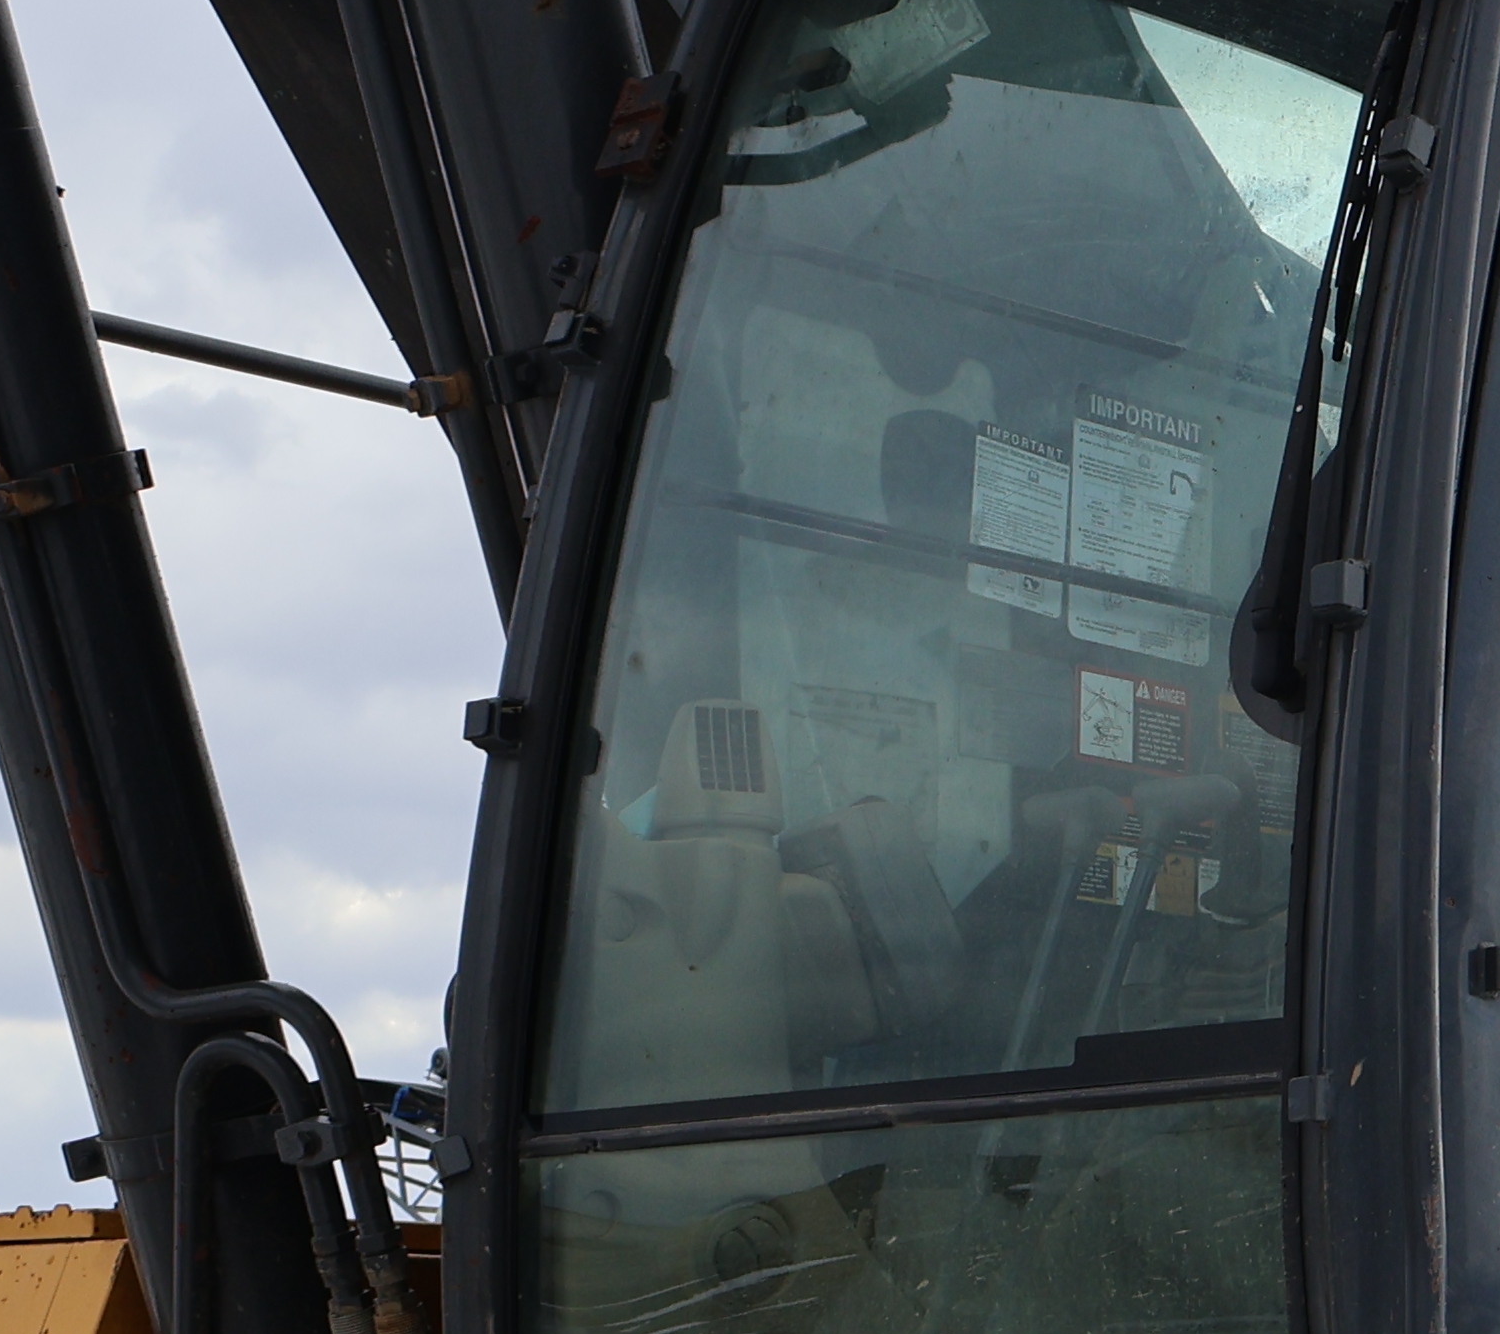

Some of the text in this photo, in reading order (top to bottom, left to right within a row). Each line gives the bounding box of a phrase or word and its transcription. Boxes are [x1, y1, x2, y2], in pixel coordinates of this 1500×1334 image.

[1090, 394, 1201, 443] IMPORTANT
[987, 425, 1064, 460] IMPORTANT
[1154, 686, 1186, 706] DANGER
